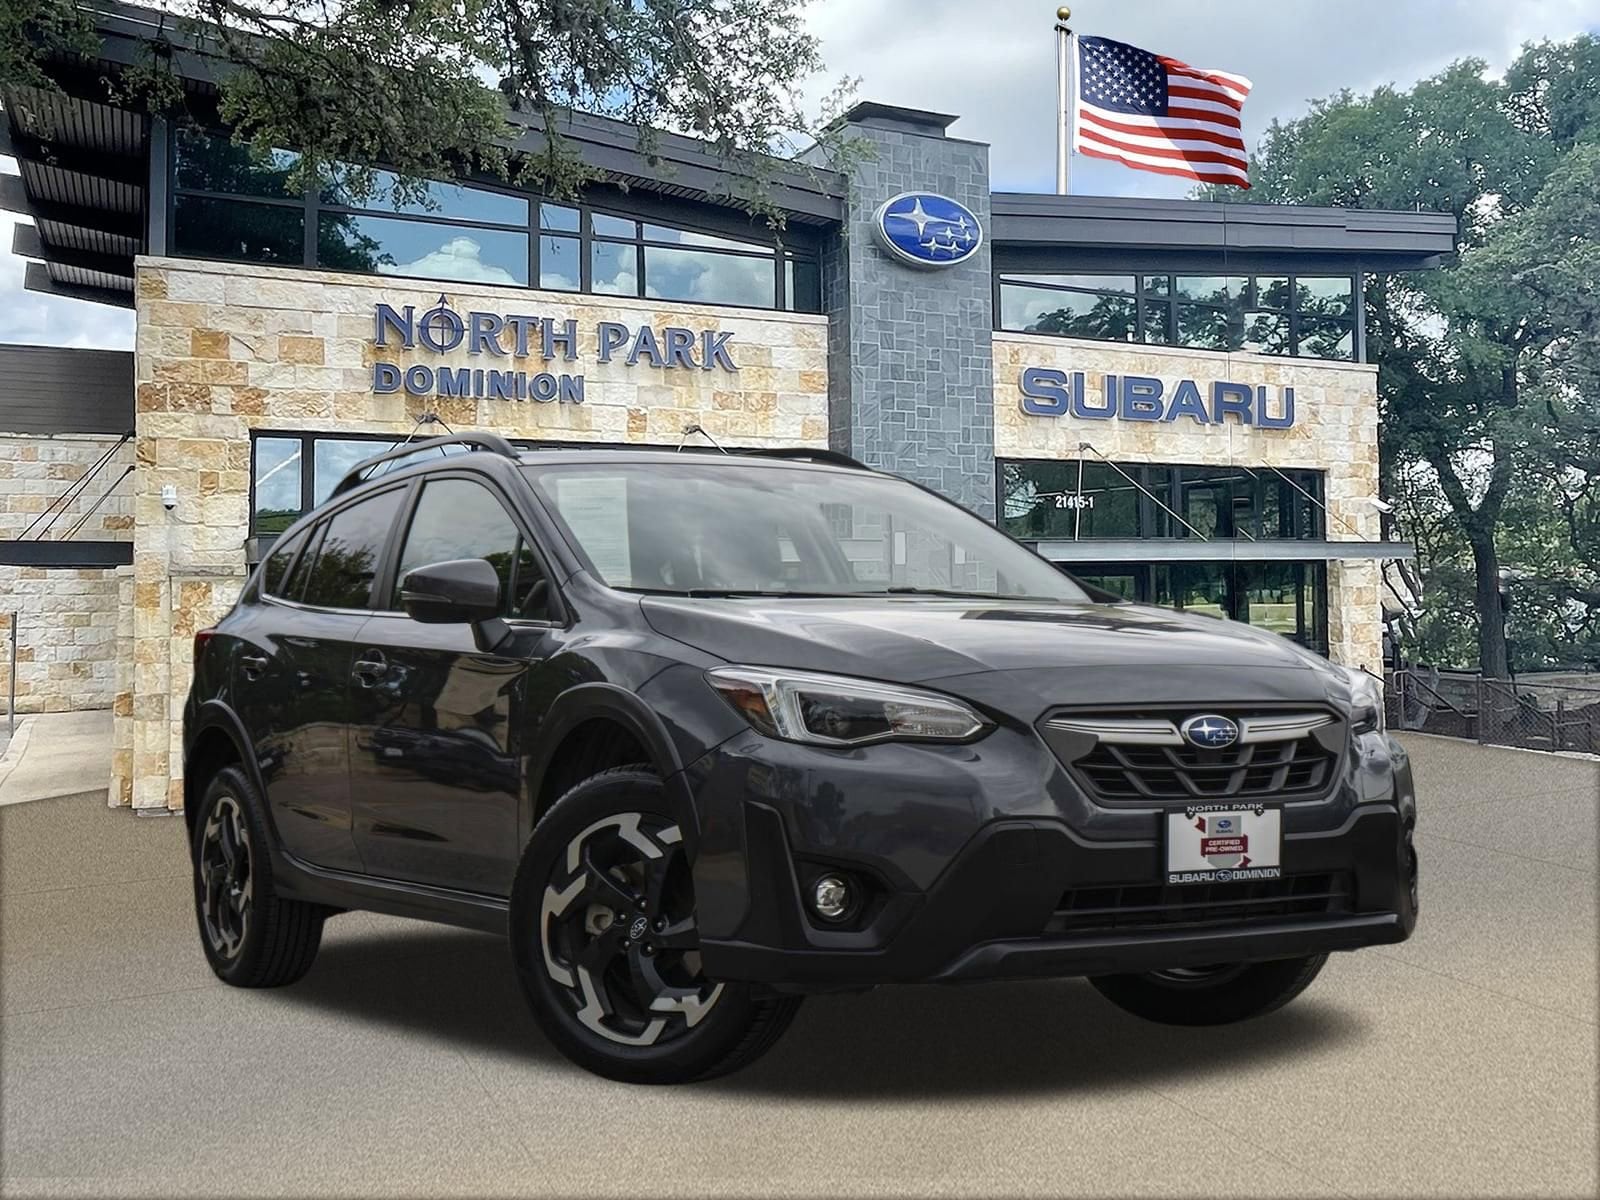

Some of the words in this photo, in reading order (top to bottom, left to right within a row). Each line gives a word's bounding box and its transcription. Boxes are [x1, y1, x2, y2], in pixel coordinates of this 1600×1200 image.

[375, 302, 579, 361] NORTH
[596, 321, 741, 373] PARK
[373, 362, 585, 404] DOMINION
[1019, 367, 1295, 429] SUBARU
[1055, 495, 1094, 508] 21415-1
[1169, 873, 1215, 883] SUBARU
[1232, 868, 1280, 880] DOMINION
